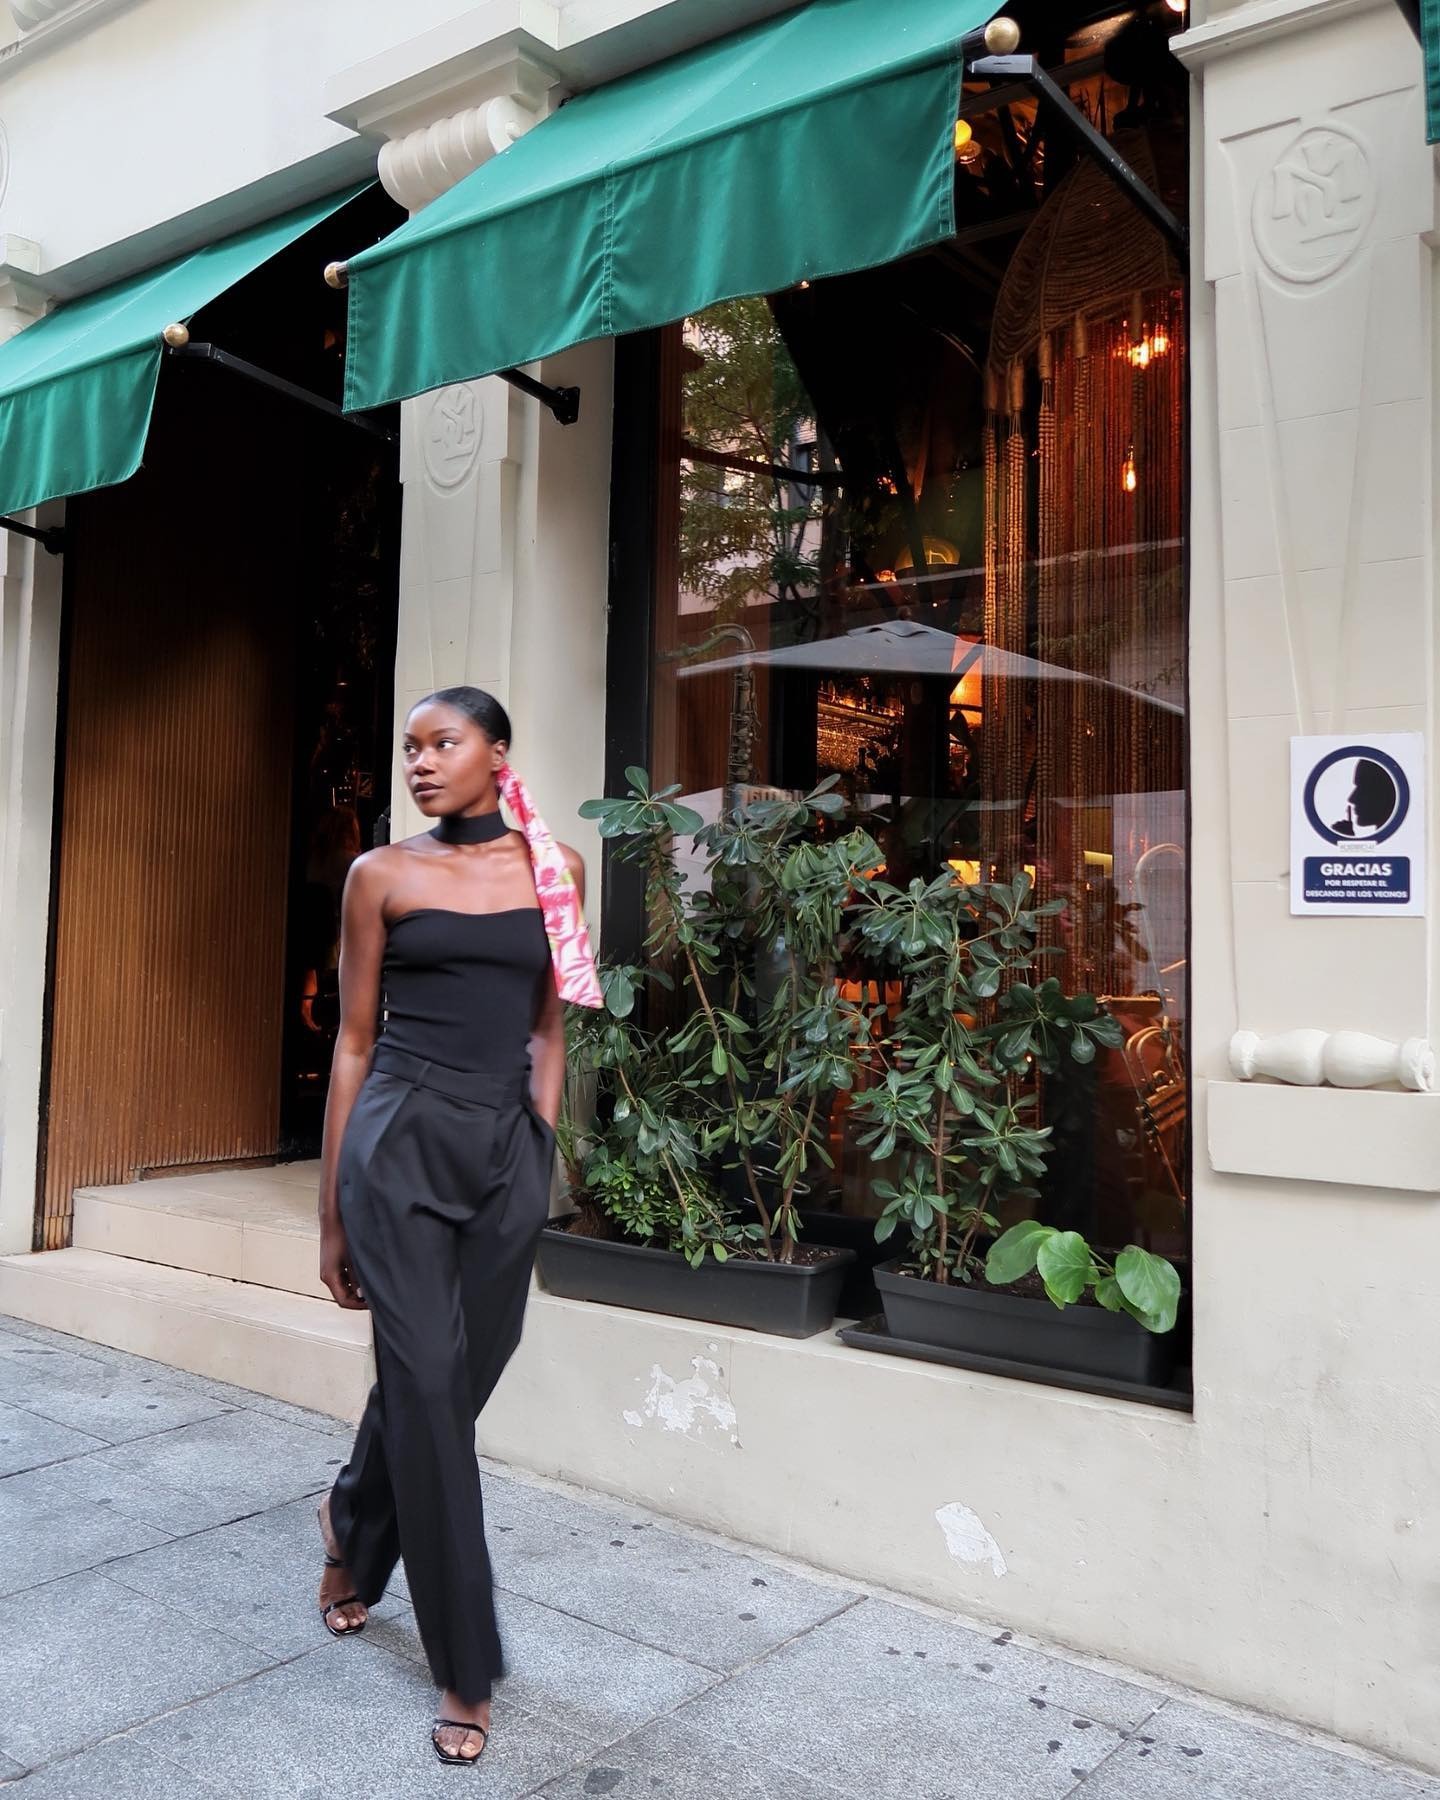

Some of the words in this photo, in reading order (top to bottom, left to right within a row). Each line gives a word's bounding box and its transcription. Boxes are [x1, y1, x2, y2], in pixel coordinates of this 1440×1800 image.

[1320, 863, 1392, 876] GRACIAS
[1346, 890, 1356, 898] DE
[1357, 890, 1373, 898] LOS
